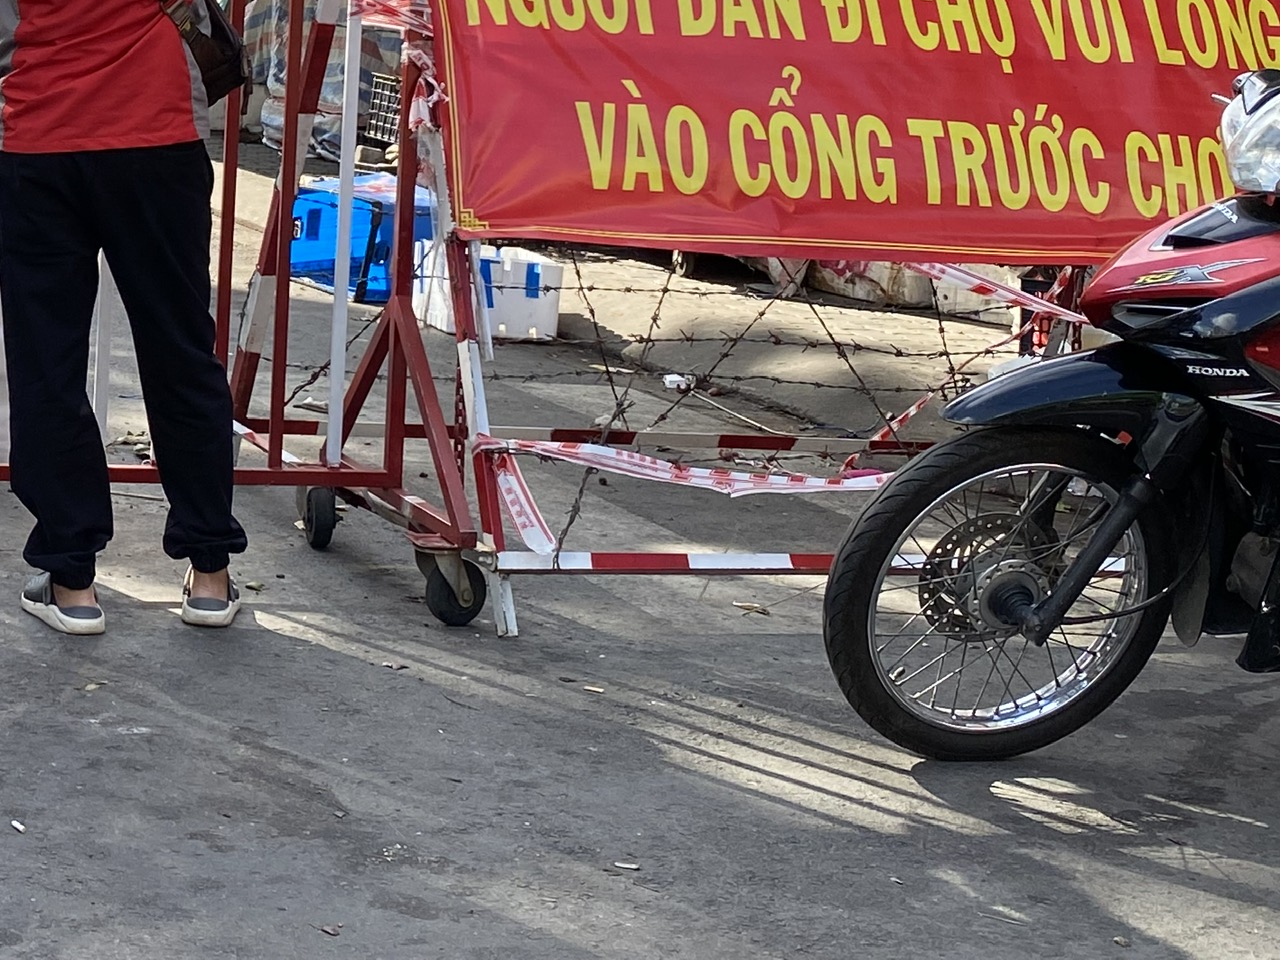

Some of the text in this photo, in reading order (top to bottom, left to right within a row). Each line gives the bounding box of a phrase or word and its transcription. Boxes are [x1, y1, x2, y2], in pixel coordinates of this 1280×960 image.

[574, 78, 710, 196] VÀO
[728, 64, 899, 205] CỔNG
[908, 102, 1110, 218] TRƯỚC
[1186, 364, 1250, 377] HONDA
